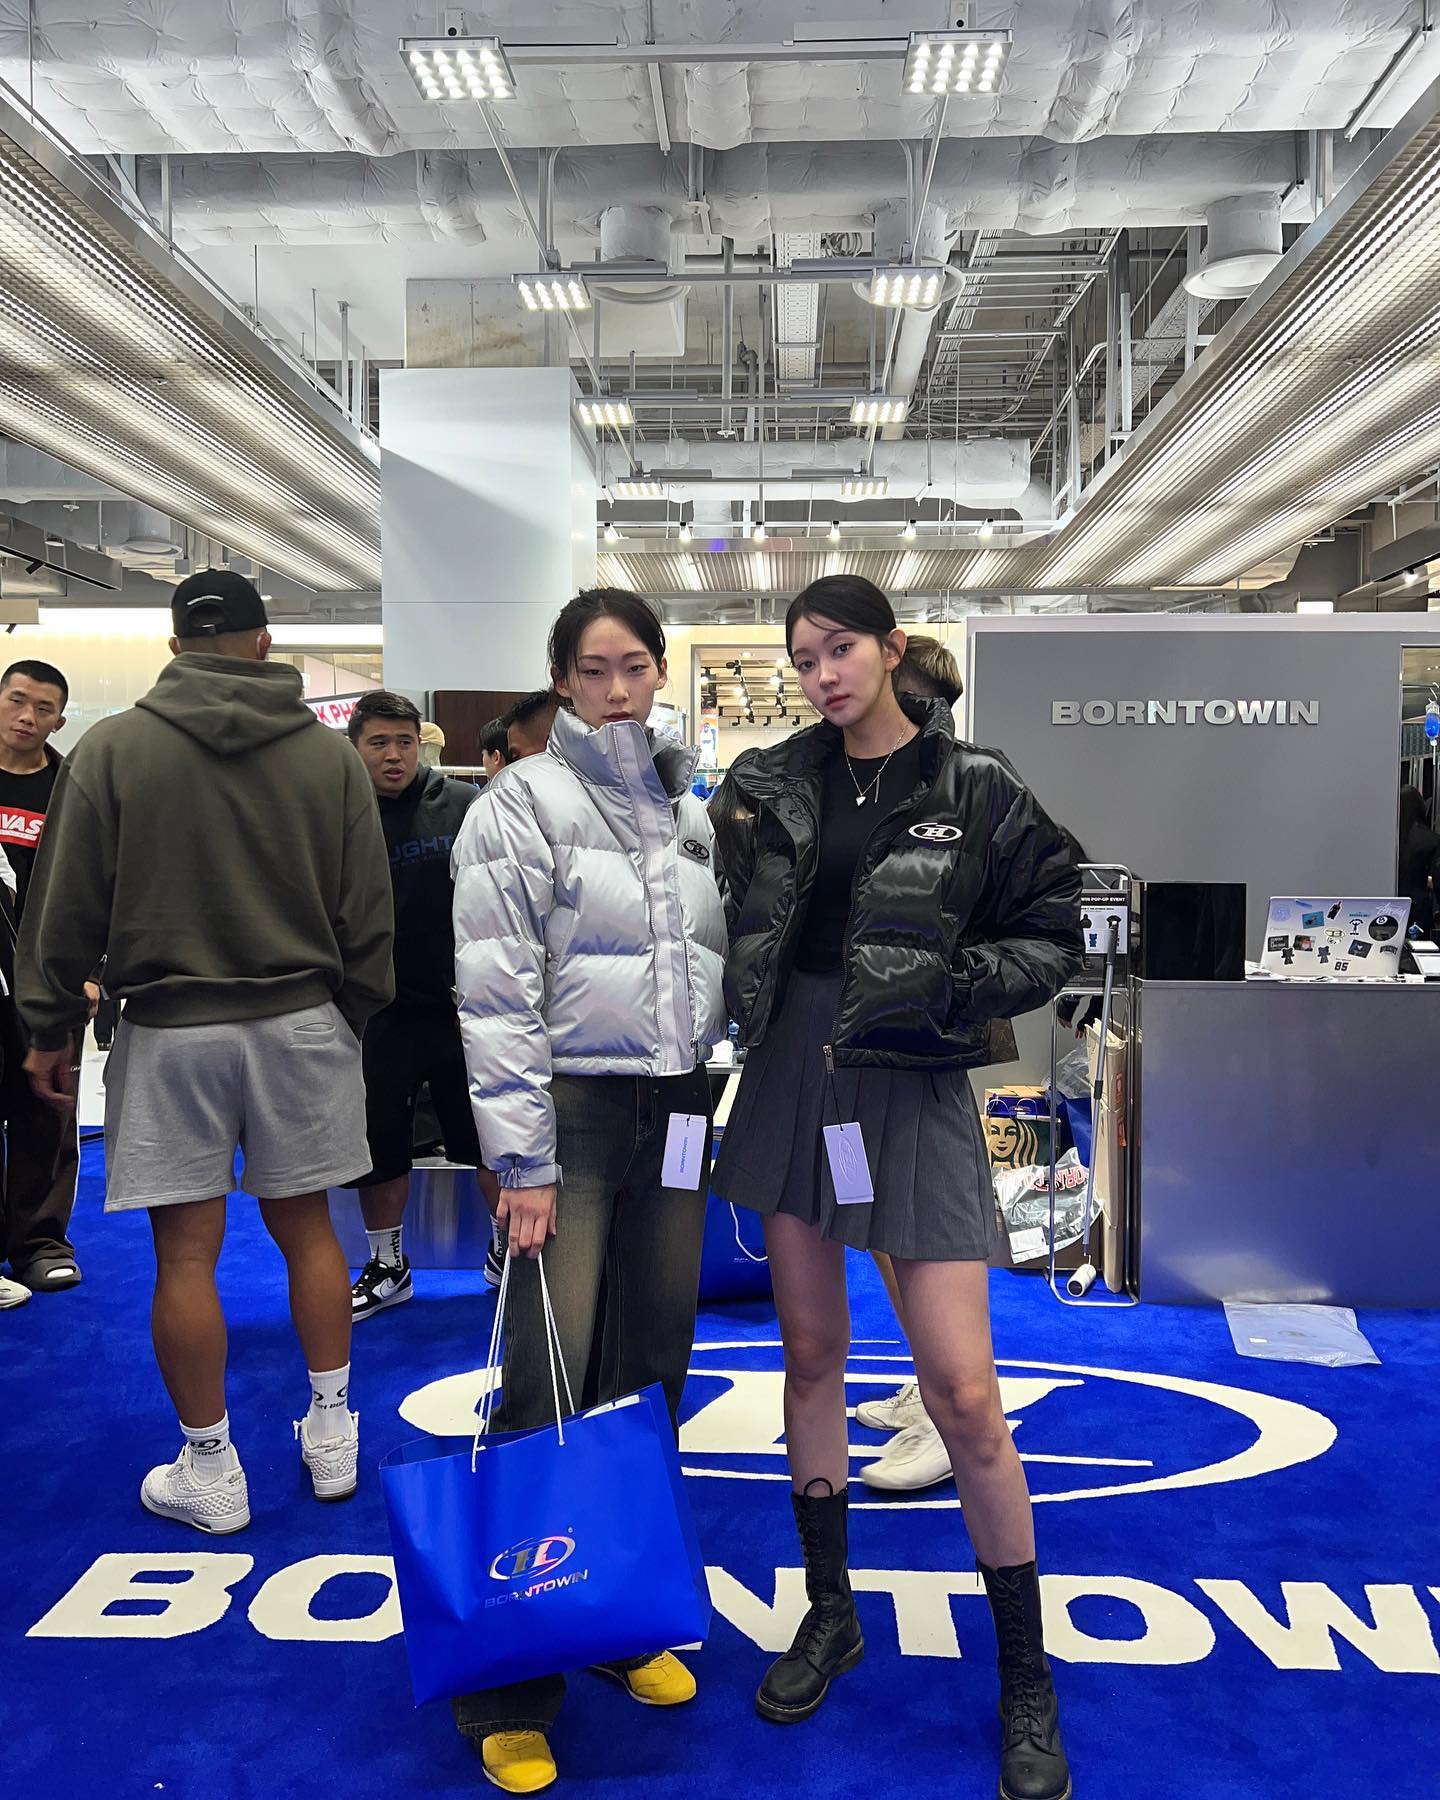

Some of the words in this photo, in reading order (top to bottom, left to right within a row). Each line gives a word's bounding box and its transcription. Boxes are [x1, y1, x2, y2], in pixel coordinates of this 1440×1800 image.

[1052, 699, 1320, 725] BORNTOWIN
[0, 813, 44, 835] VAS
[1334, 961, 1349, 971] 85
[484, 1568, 589, 1609] BORNTOWIN
